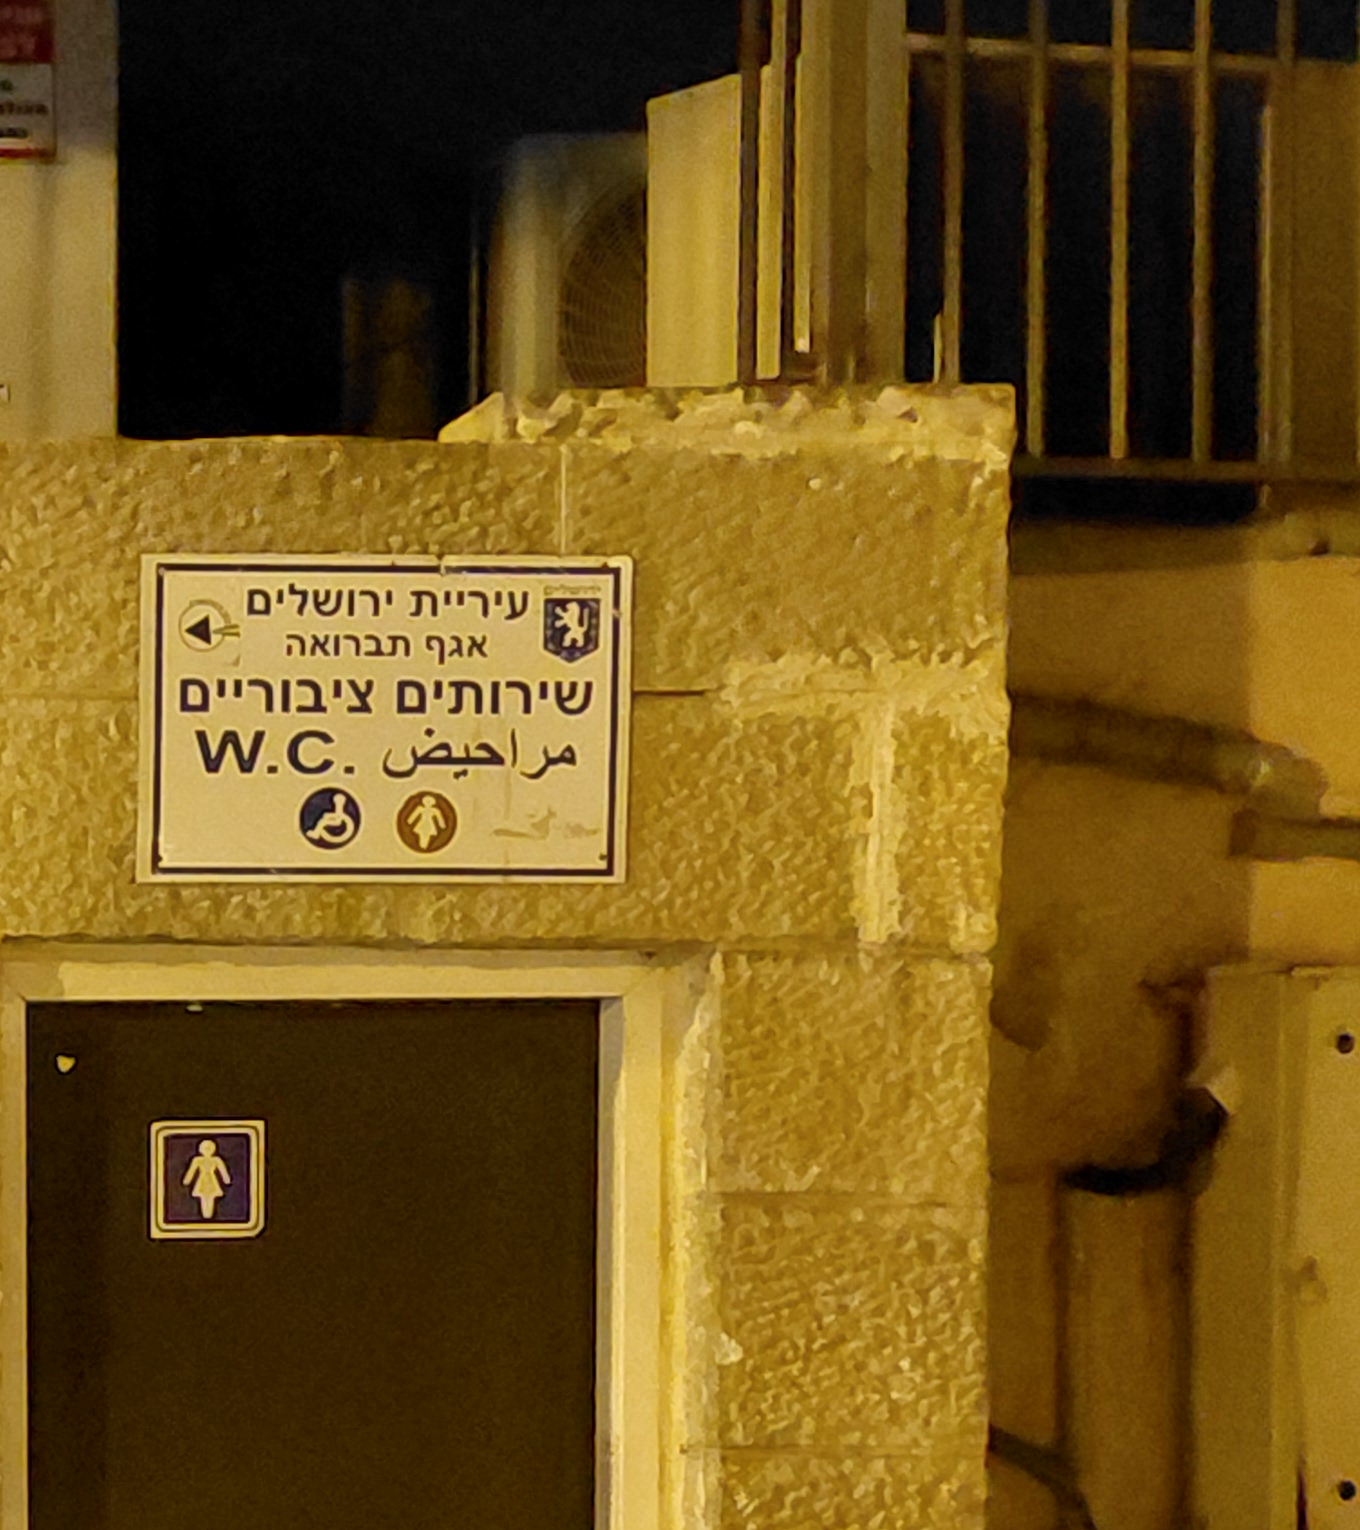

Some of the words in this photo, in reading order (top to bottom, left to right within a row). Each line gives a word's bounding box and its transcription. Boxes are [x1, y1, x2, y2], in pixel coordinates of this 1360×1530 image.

[247, 583, 393, 617] ירושלים
[410, 590, 530, 620] עיריית
[286, 634, 411, 658] תברואה
[426, 634, 488, 666] אגף
[180, 678, 375, 715] ציבוריים
[397, 679, 594, 716] שירותים
[195, 730, 355, 775] W.C.
[383, 728, 577, 780] مراحيض
